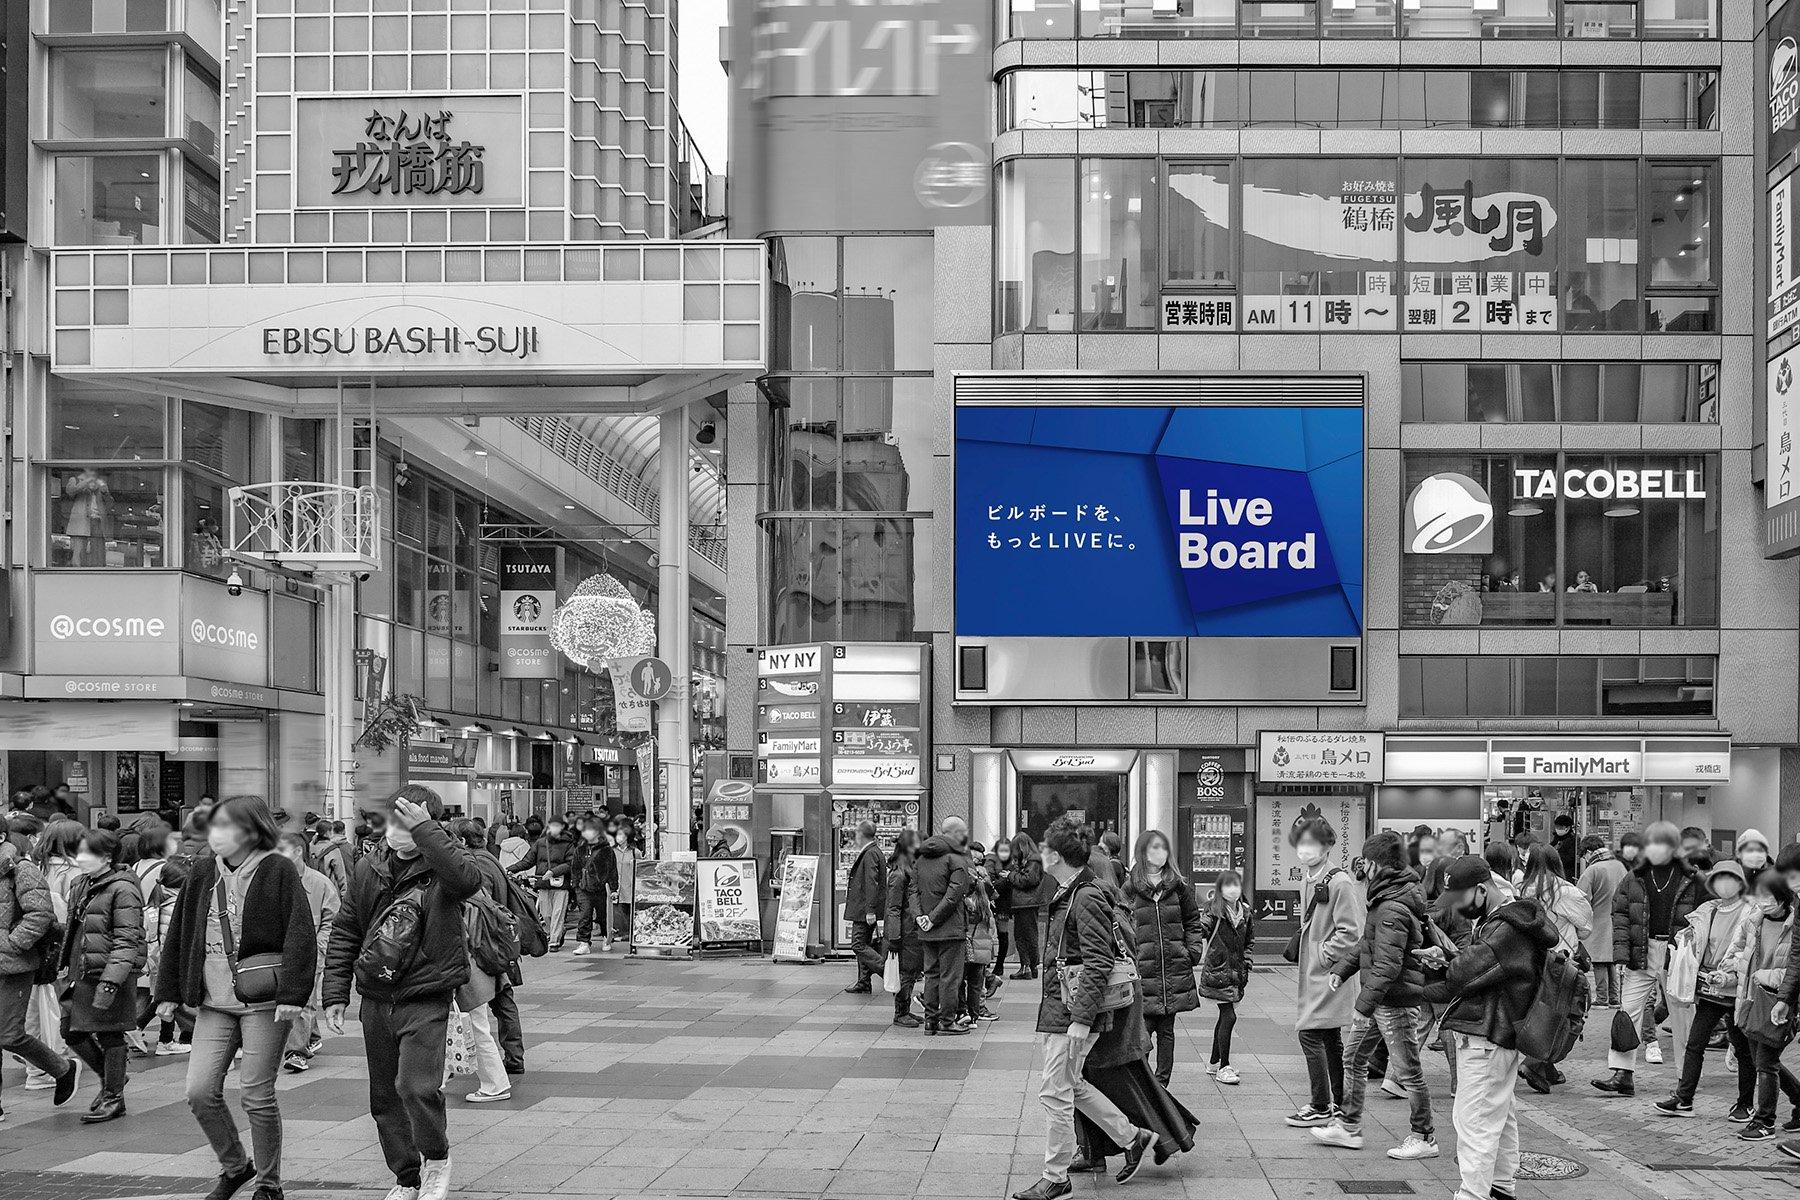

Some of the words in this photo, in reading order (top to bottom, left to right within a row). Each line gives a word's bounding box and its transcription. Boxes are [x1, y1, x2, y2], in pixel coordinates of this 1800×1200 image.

[1770, 80, 1798, 117] TACO
[1773, 99, 1799, 133] BELL
[365, 110, 453, 141] なんば
[332, 142, 485, 195] 戎橋筋
[1342, 181, 1395, 192] お好み焼き
[1342, 206, 1395, 231] 鶴橋
[1404, 179, 1544, 256] 風月
[1774, 189, 1785, 290] FamilyMart
[1368, 274, 1546, 294] 時短営業中
[1165, 301, 1232, 327] 営業時間
[262, 327, 355, 354] EBISU
[365, 326, 538, 359] BASHI-SUJI
[987, 504, 1122, 522] ビルボードを、
[1179, 489, 1273, 527] Live
[987, 532, 1137, 551] もっとLIVEに。
[1179, 533, 1316, 569] Board
[506, 564, 551, 574] TSUTAYA
[50, 614, 165, 639] @cosme
[190, 618, 258, 650] @cosme
[507, 647, 549, 657] @cosme
[758, 651, 765, 660] 4
[836, 648, 844, 658] 8
[769, 654, 790, 670] NY
[794, 652, 816, 668] NY
[65, 681, 120, 693] @cosme
[125, 684, 157, 692] STORE
[760, 680, 767, 689] 3
[210, 685, 243, 698] @cosme
[244, 691, 264, 702] STORE
[760, 707, 765, 715] 2
[782, 712, 800, 720] TACO
[800, 711, 817, 719] BELL
[835, 704, 843, 714] 6
[761, 734, 766, 743] 1
[835, 732, 844, 742] 5
[593, 747, 618, 762] TSUTAYA
[773, 741, 817, 753] FamilyMart
[1201, 761, 1221, 769] COFFEE
[1533, 757, 1630, 776] FamilyMart
[1694, 765, 1721, 774] 戎橋店
[1197, 787, 1224, 797] BOSS
[714, 888, 742, 897] TACO
[725, 908, 740, 917] 2F
[1262, 900, 1286, 912] 入口
